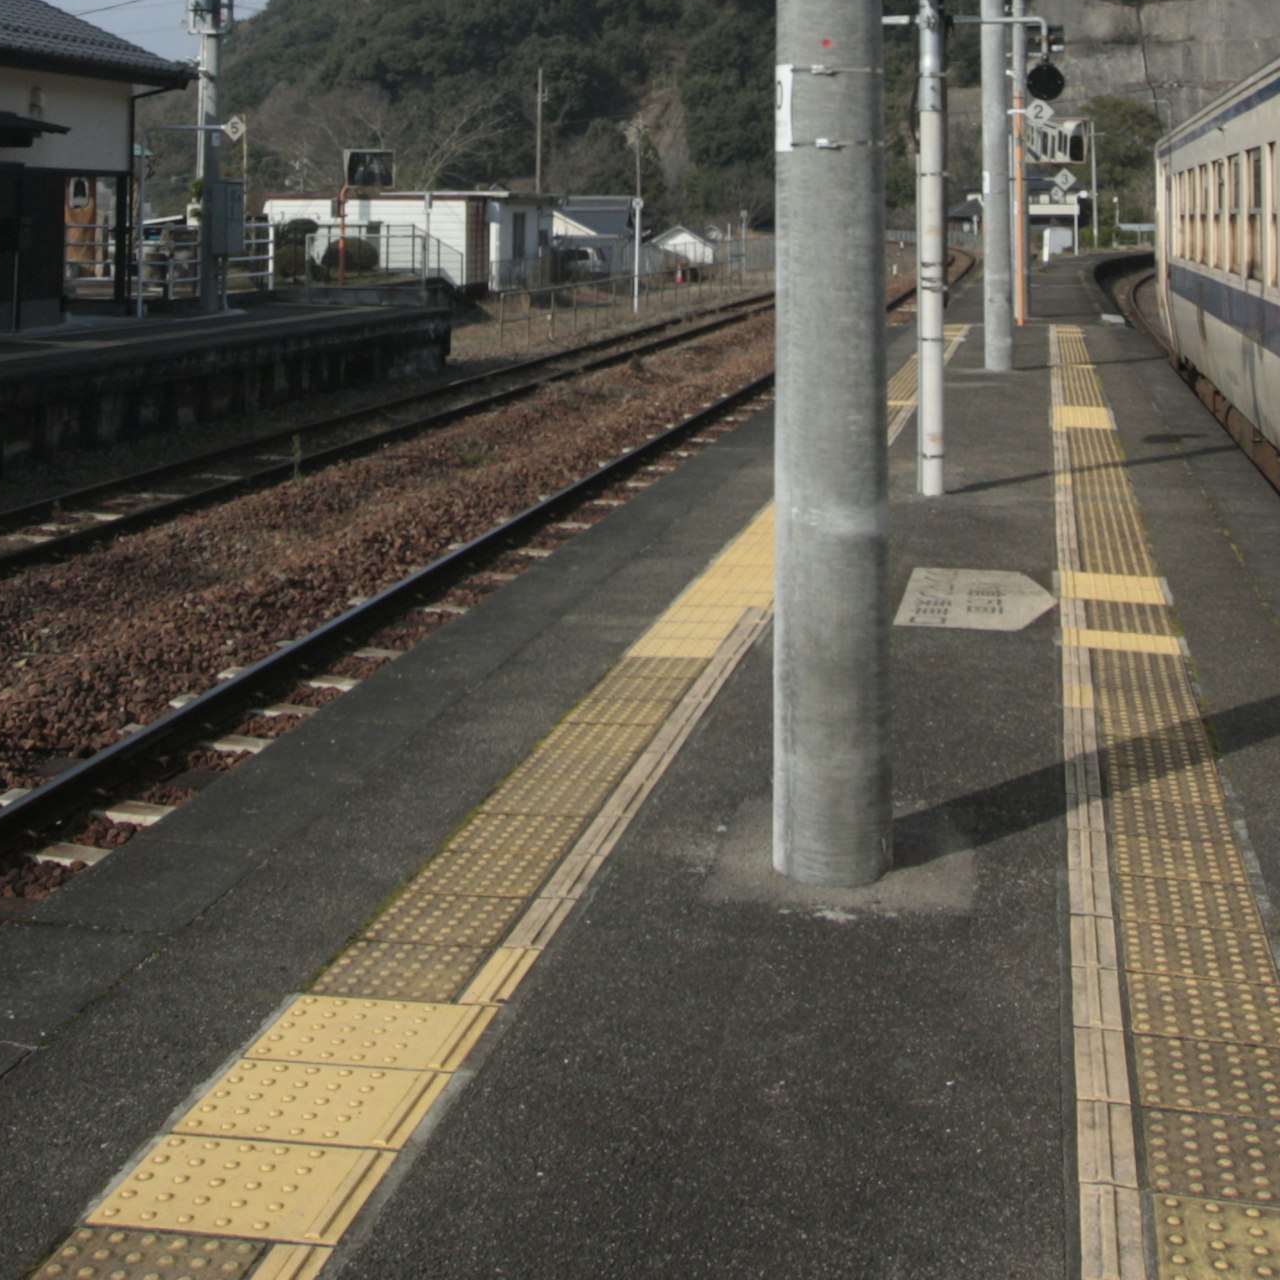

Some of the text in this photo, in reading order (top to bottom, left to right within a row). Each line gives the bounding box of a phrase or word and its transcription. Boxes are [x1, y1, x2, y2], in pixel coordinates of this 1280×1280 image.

[1033, 104, 1044, 119] 2
[230, 121, 239, 134] 5
[1061, 174, 1068, 185] 3
